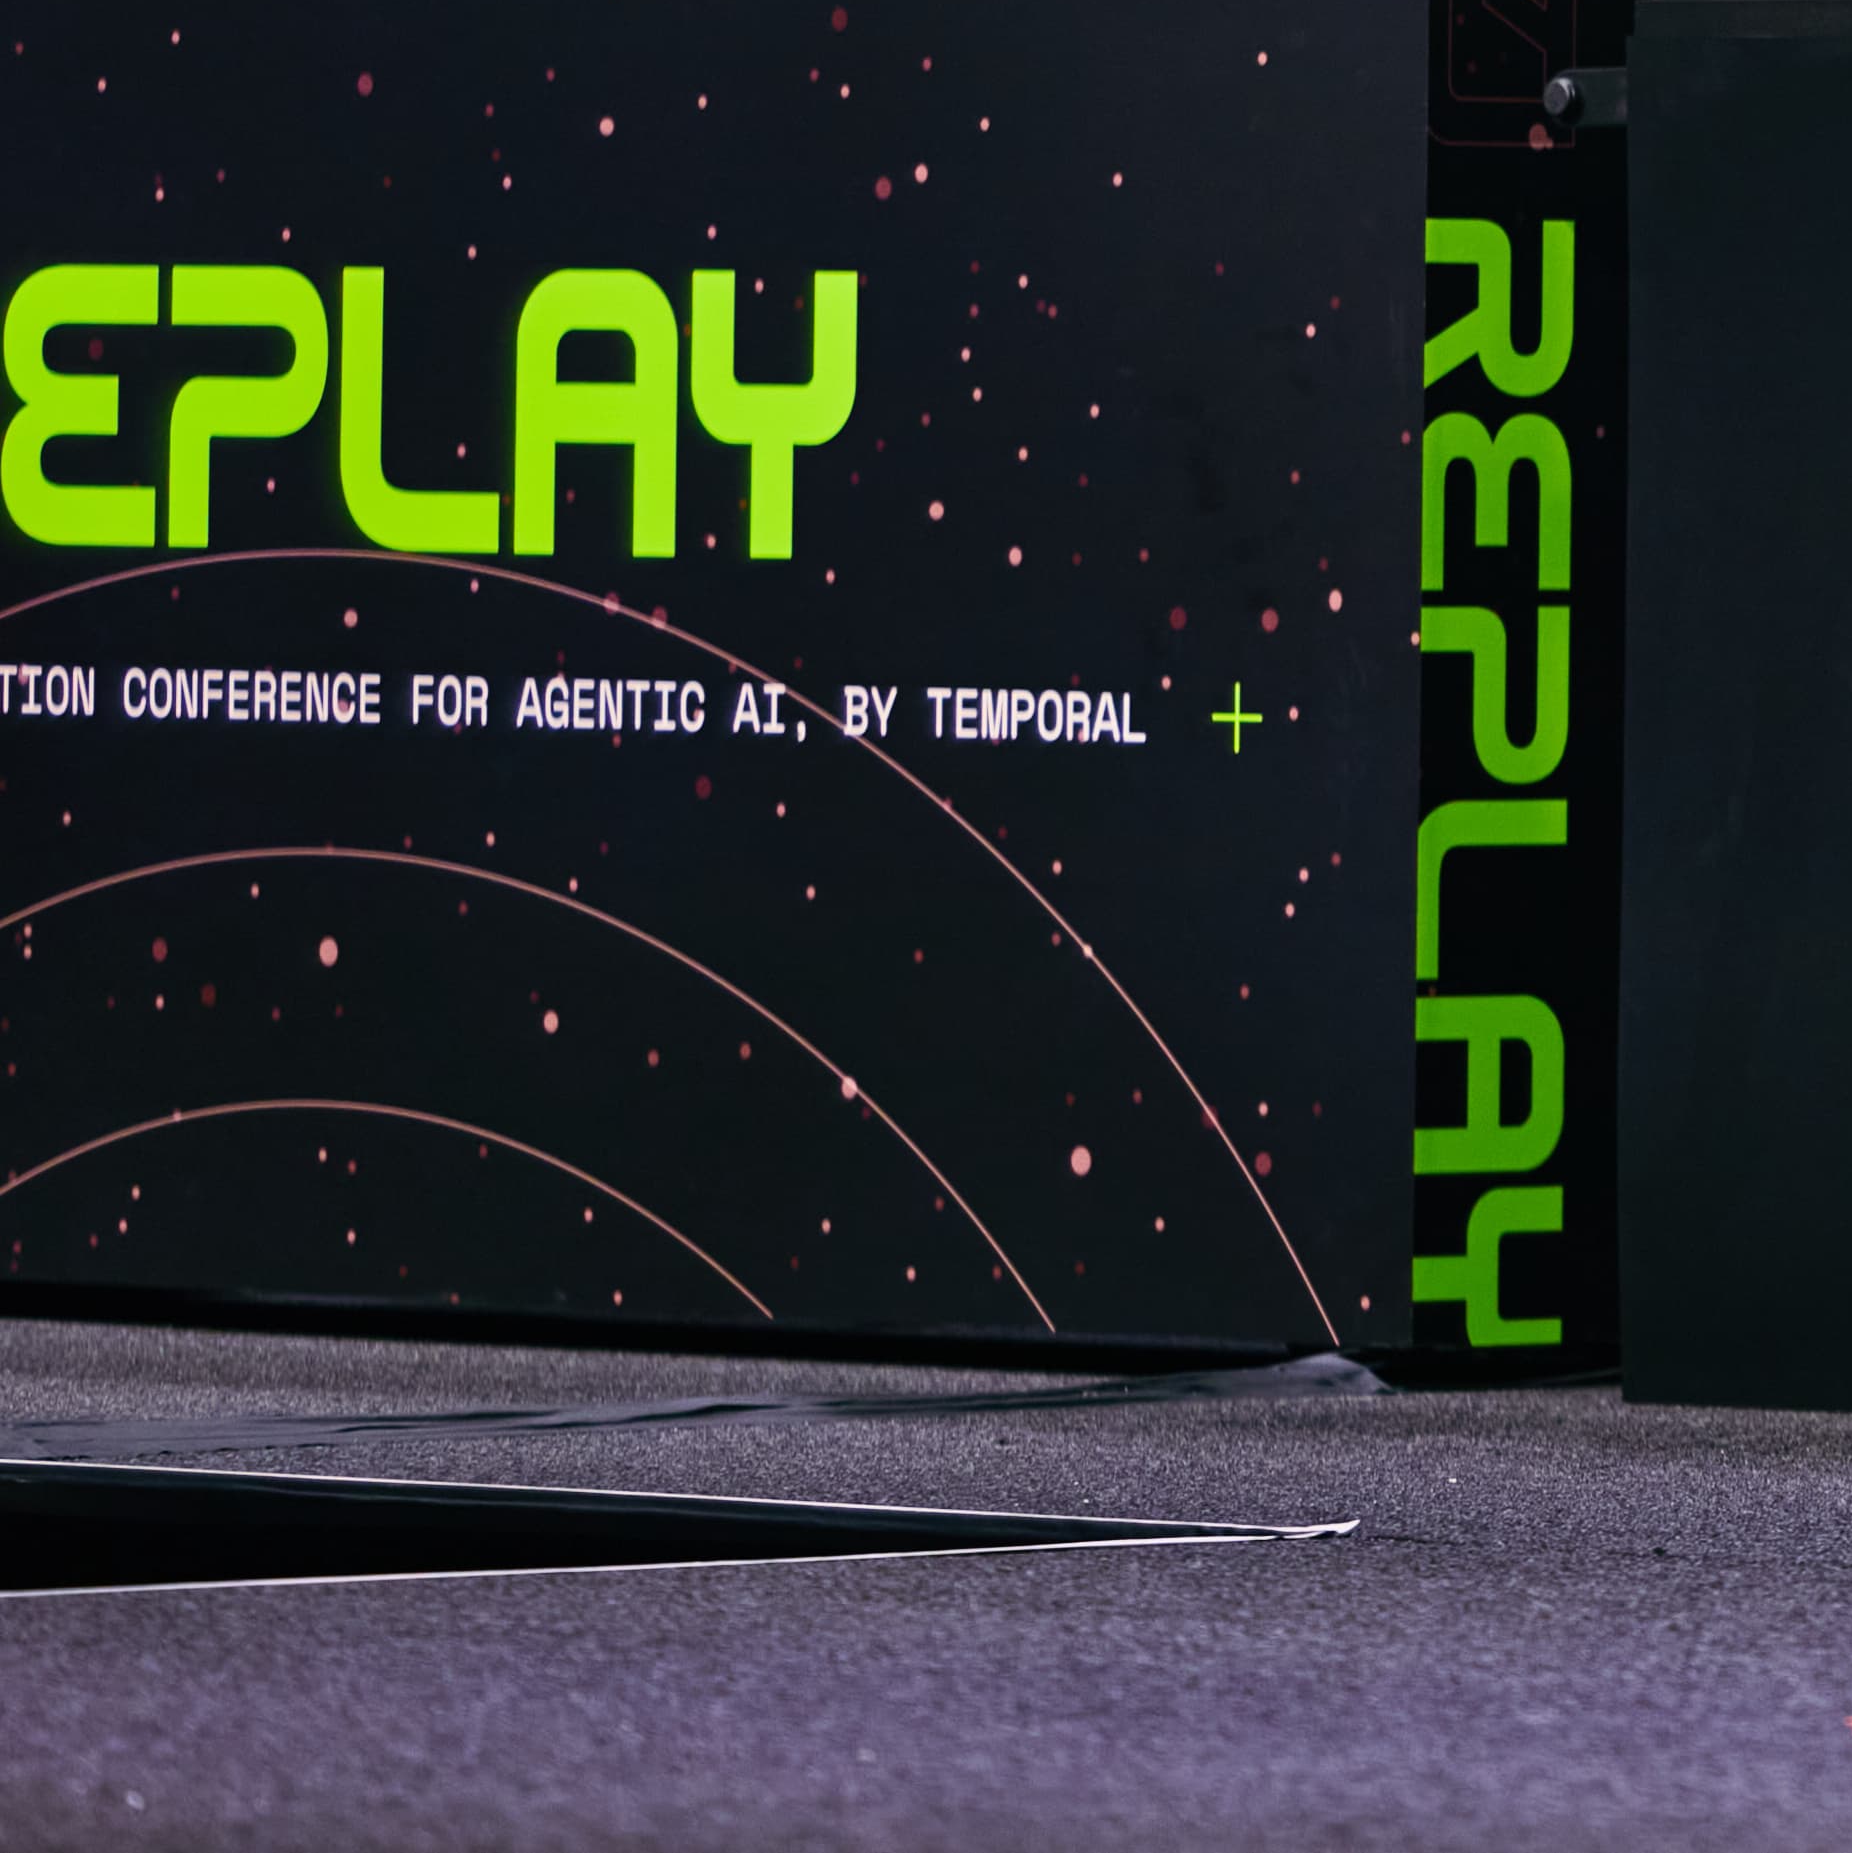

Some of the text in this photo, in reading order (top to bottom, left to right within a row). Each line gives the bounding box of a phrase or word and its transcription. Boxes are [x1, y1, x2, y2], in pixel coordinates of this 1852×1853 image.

[0, 663, 1147, 744] TION CONFERENCE FOR AGENTIC AI, BY TEMPORAL
[1411, 217, 1575, 1346] REPLAY
